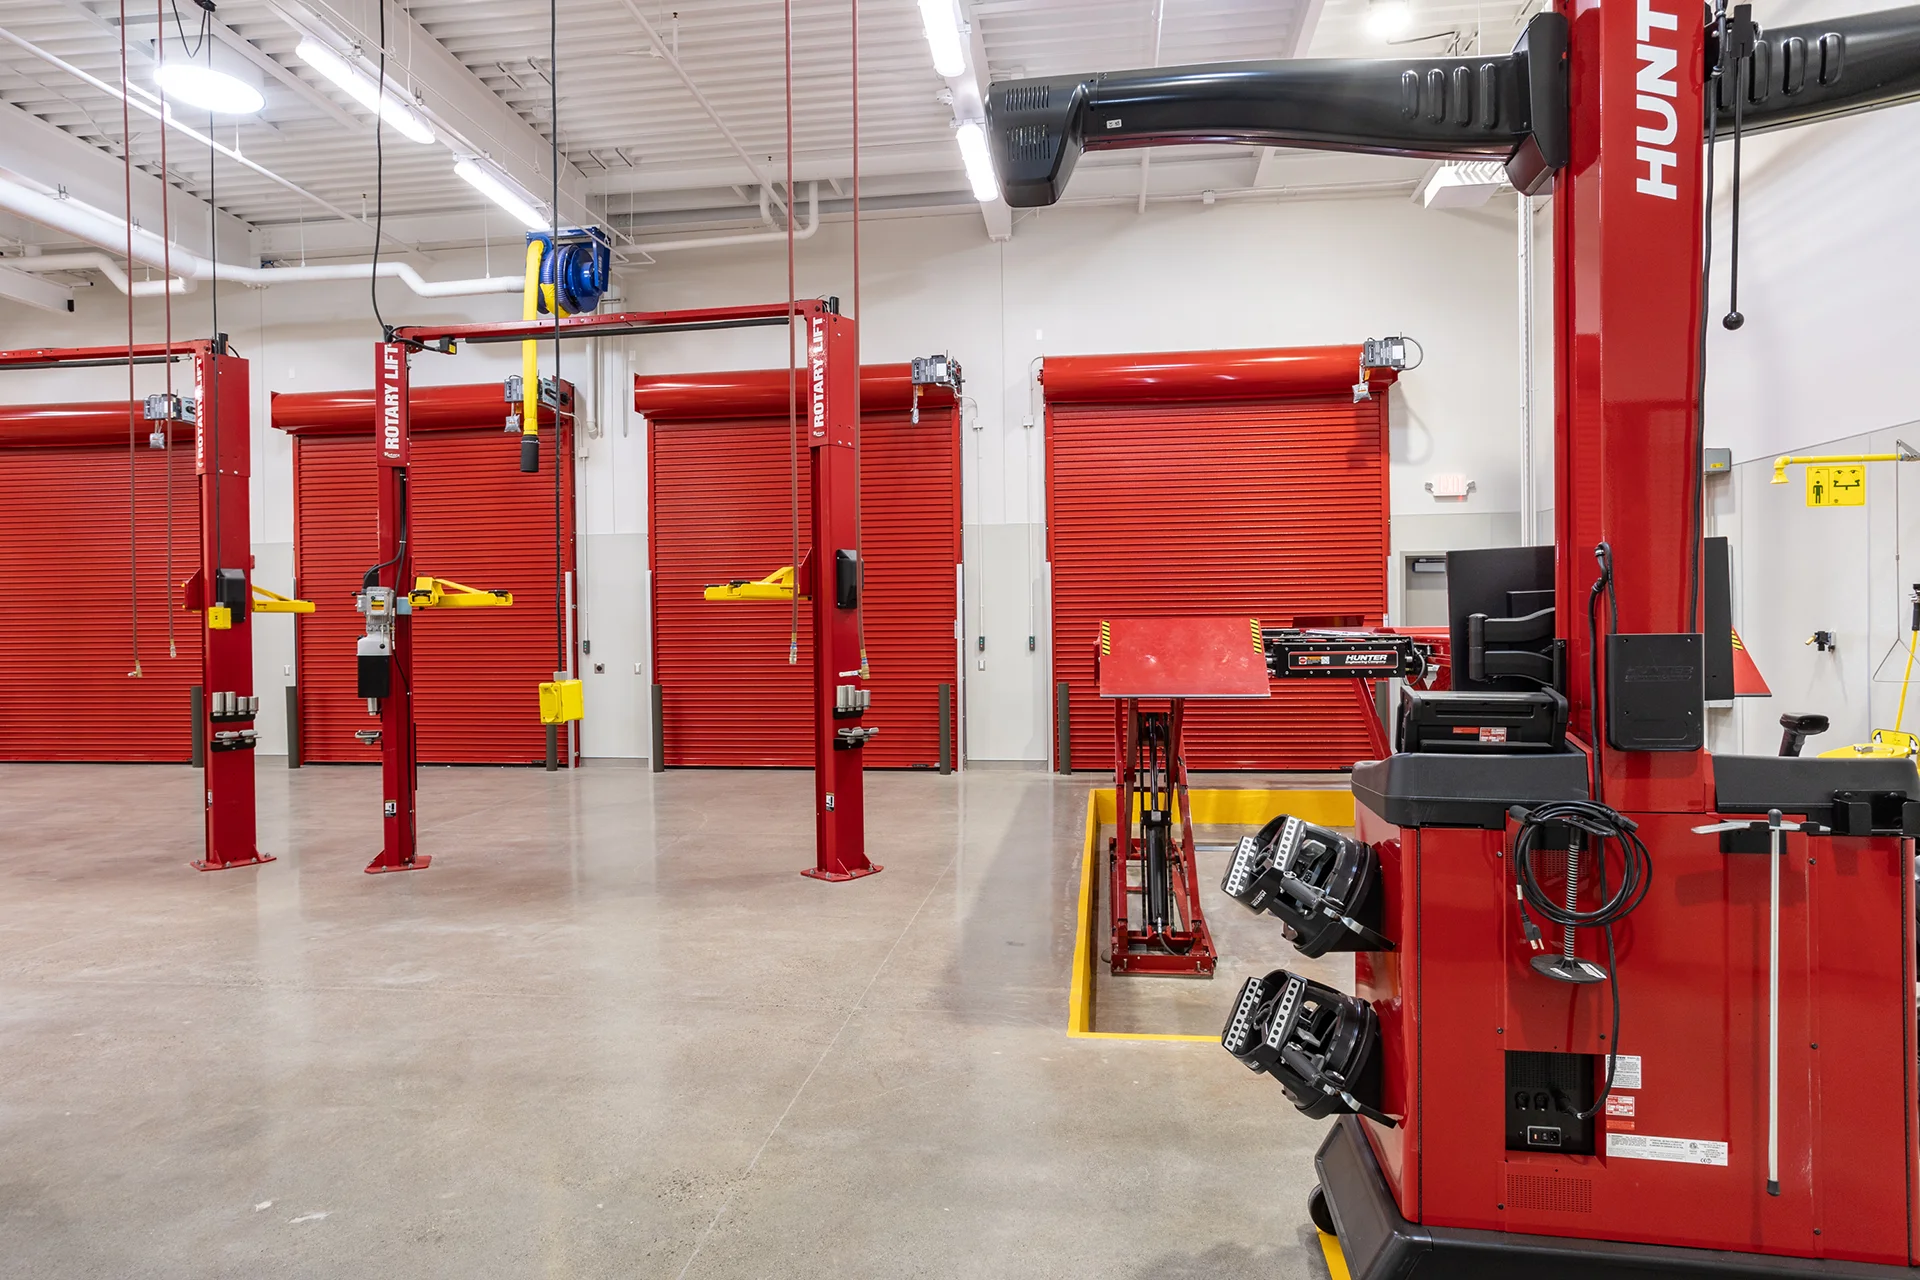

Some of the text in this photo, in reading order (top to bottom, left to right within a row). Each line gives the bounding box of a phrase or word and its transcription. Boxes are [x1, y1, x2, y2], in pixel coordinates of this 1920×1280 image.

[812, 316, 824, 354] LIFT
[384, 344, 400, 450] ROTARY LIFT
[813, 358, 825, 428] ROTARY
